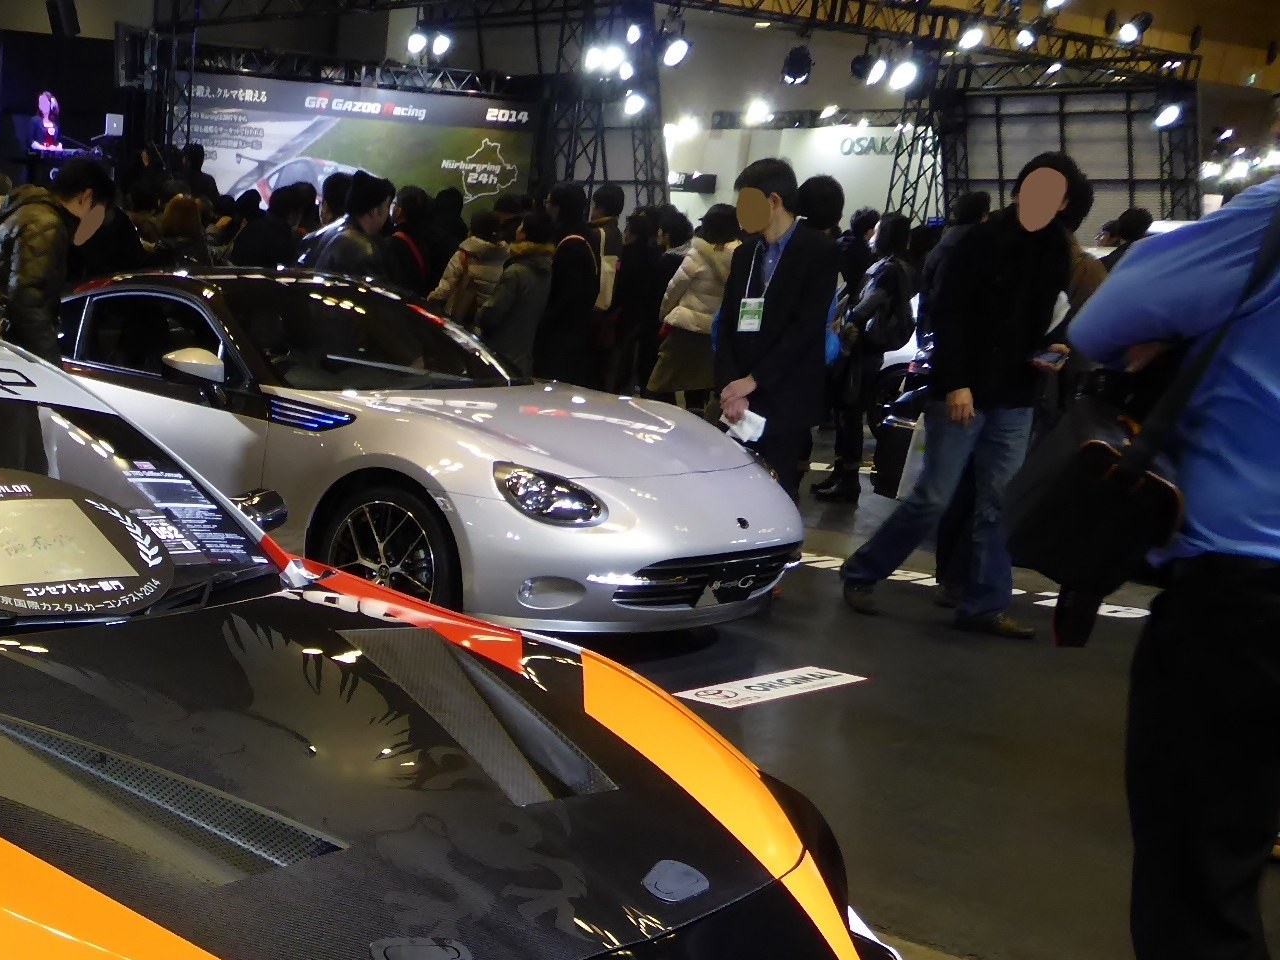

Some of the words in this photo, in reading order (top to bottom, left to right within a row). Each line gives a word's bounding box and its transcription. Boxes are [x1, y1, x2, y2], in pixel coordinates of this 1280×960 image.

[305, 96, 329, 109] GR
[332, 98, 381, 114] GAZOO
[383, 103, 427, 120] Racing
[485, 107, 529, 124] 2014
[441, 159, 501, 175] Nürburgring
[467, 172, 498, 185] 24h
[22, 579, 125, 597] コンセプトカー部門
[744, 671, 843, 692] ORIGINAL
